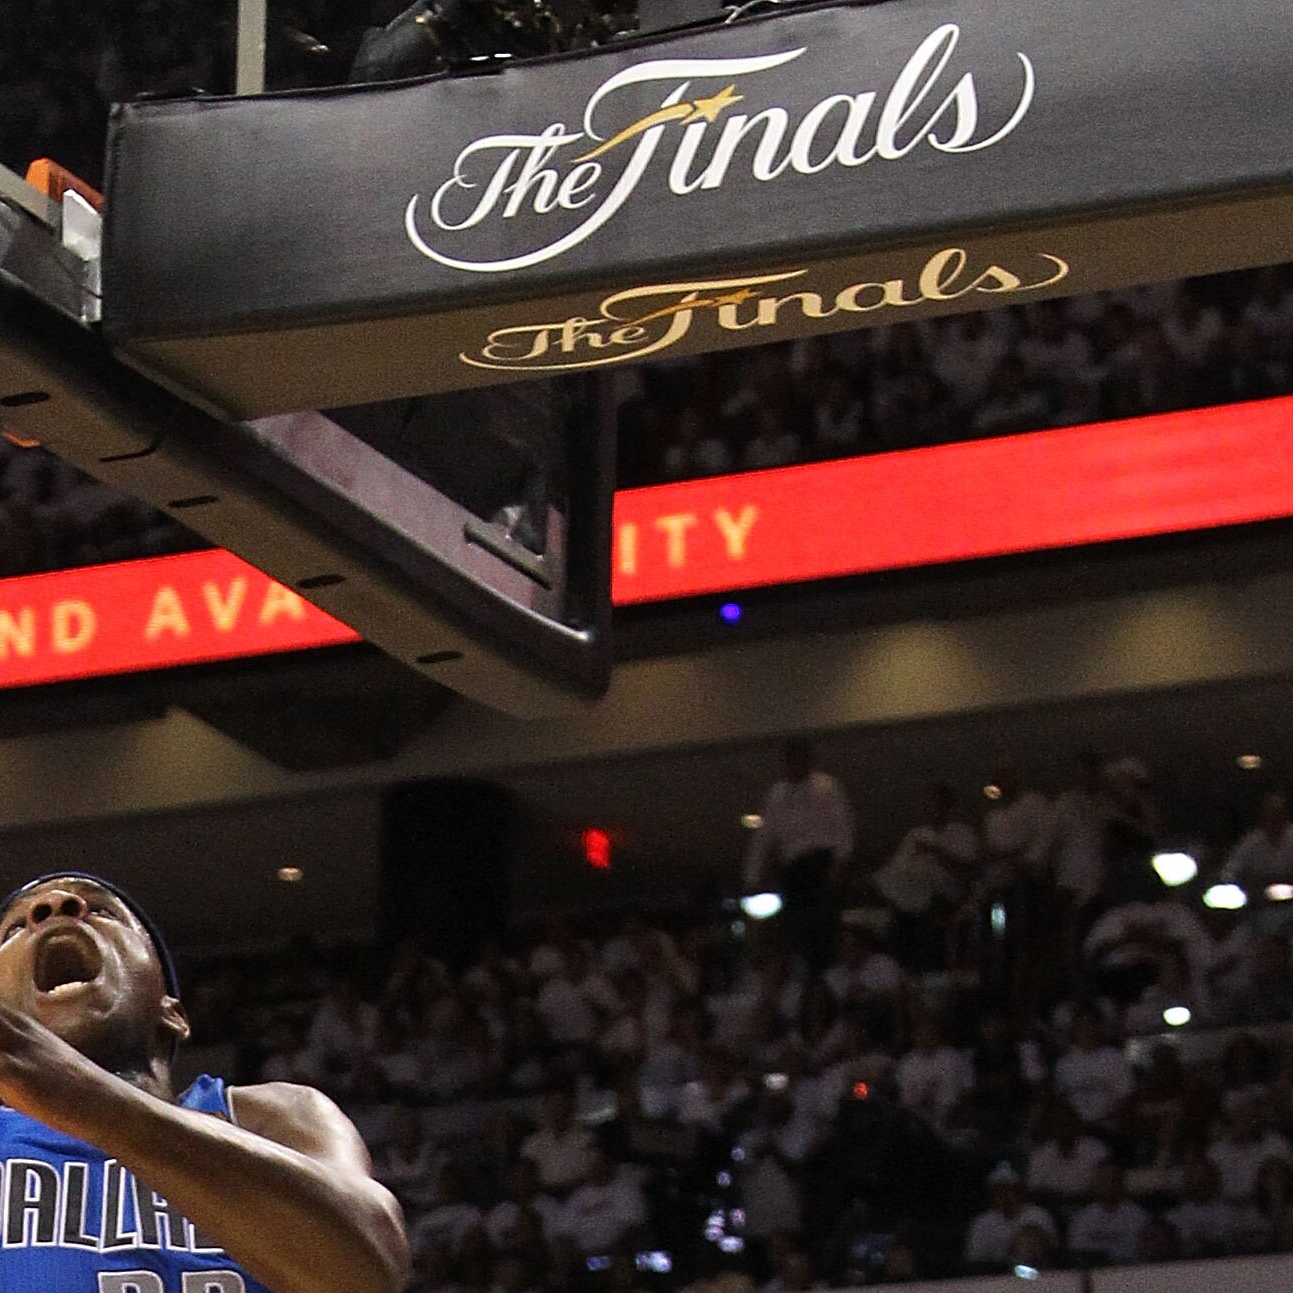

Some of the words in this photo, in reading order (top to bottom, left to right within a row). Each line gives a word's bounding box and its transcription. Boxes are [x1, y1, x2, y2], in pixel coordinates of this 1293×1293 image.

[405, 22, 1036, 272] Finals
[430, 122, 603, 232] The
[458, 247, 1069, 371] Finals
[481, 316, 646, 361] The
